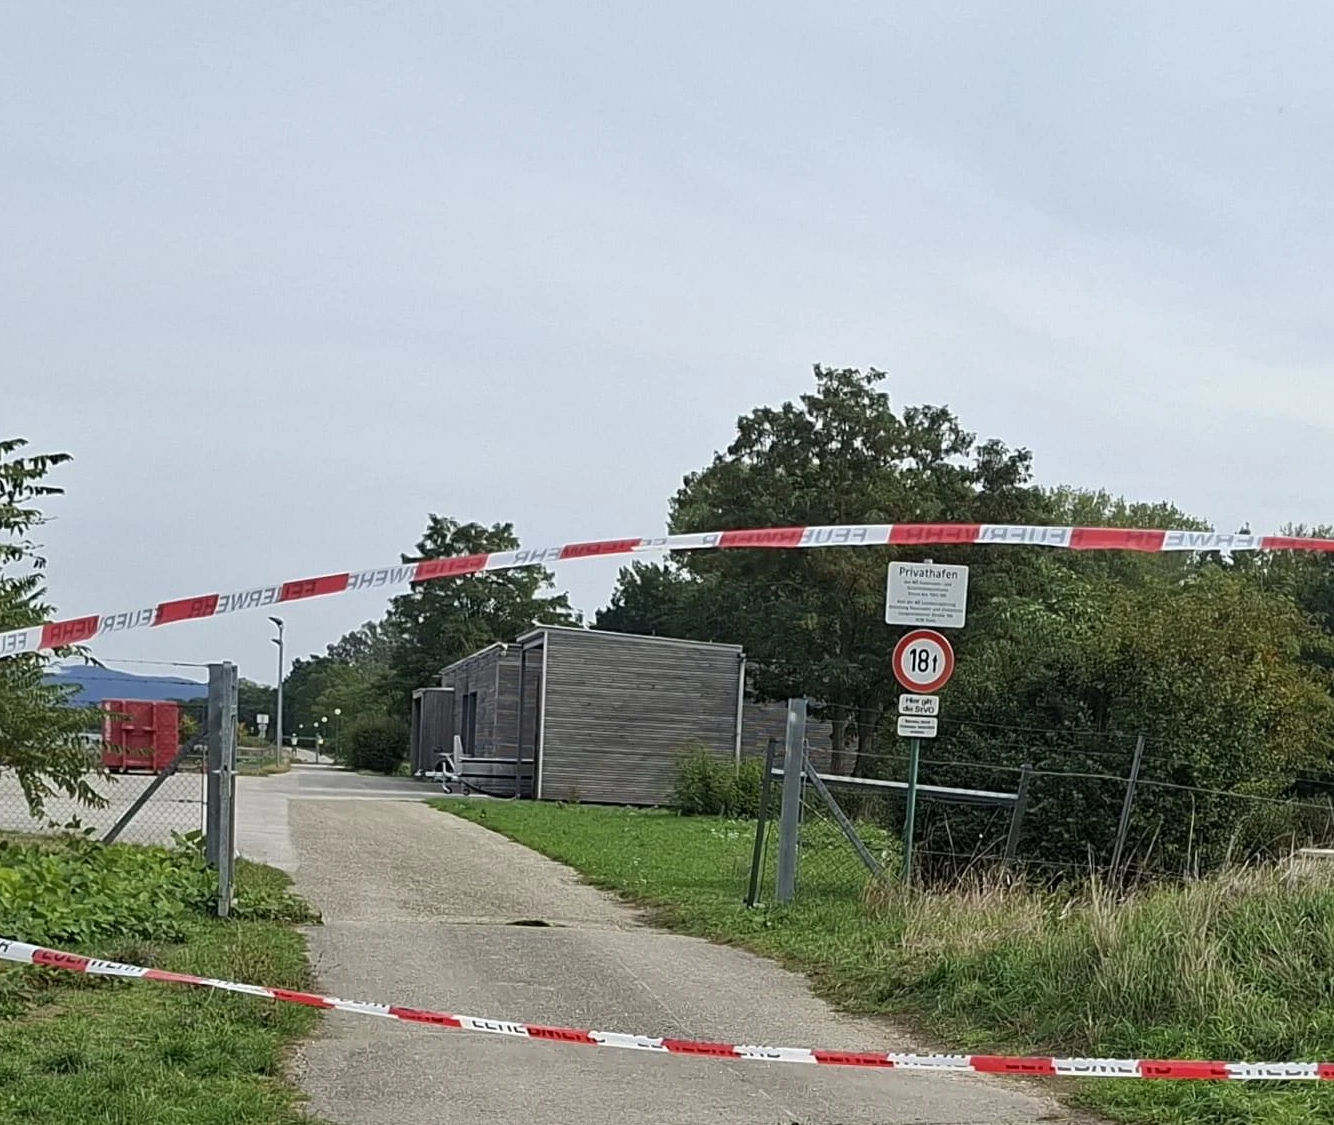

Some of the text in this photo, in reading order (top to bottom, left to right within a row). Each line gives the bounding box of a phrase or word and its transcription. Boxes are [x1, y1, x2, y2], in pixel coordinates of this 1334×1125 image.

[899, 566, 958, 579] Privathafen
[910, 648, 938, 673] 18 t
